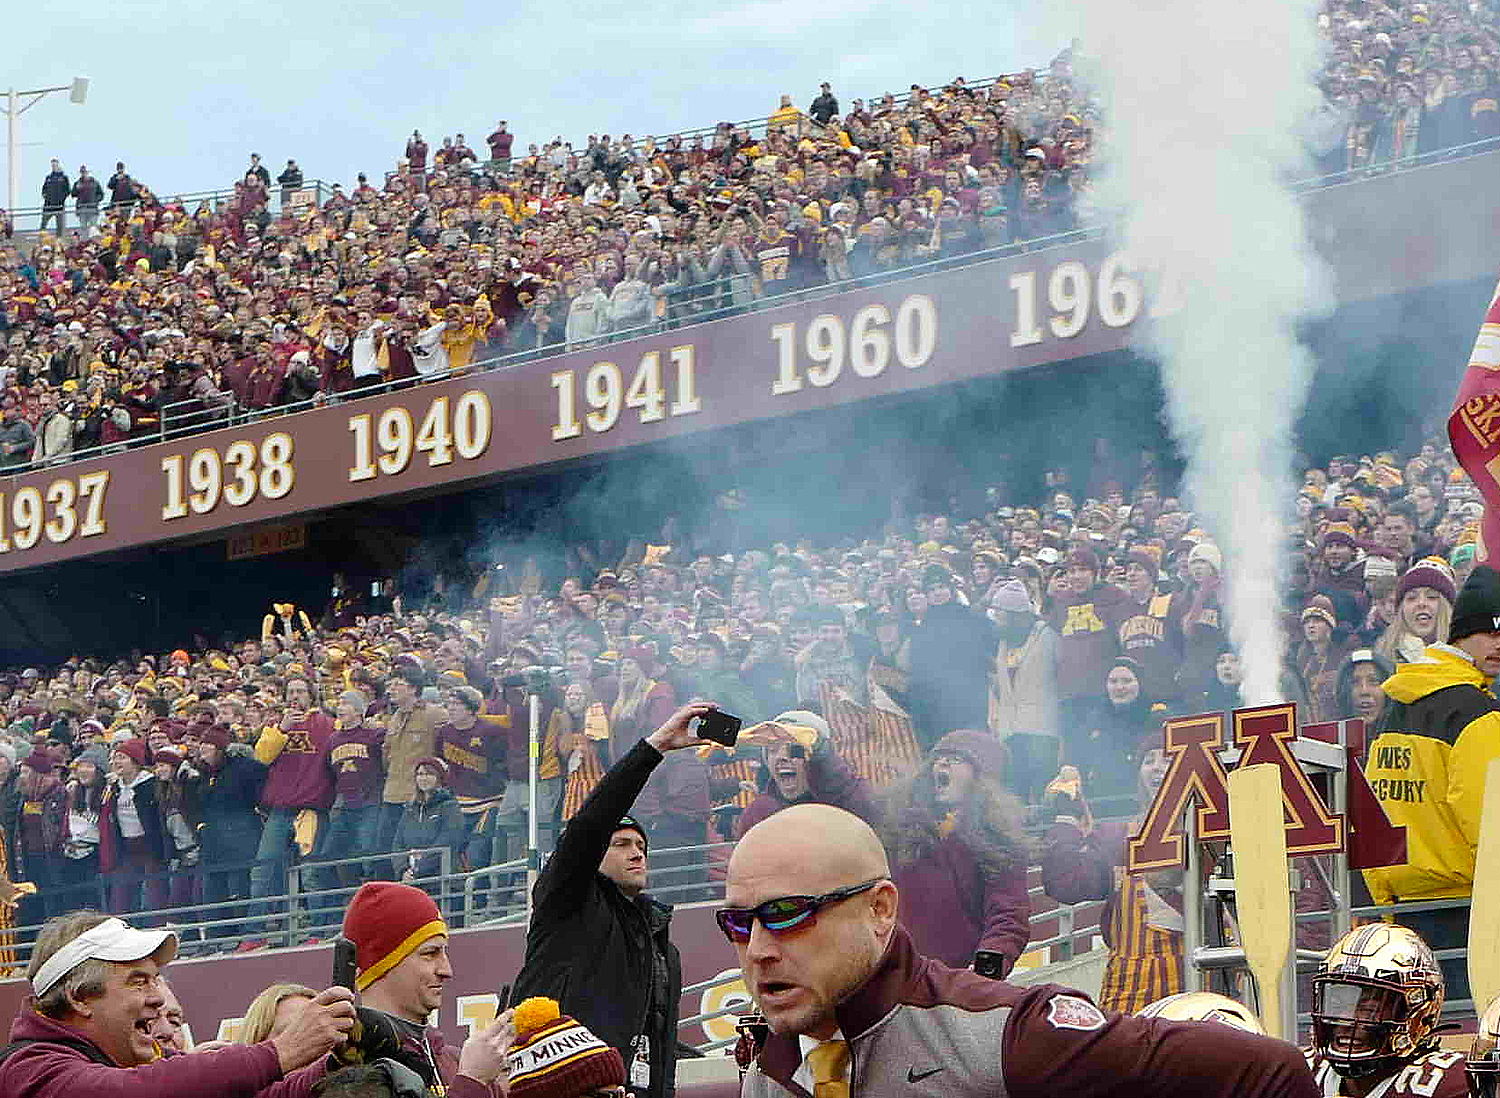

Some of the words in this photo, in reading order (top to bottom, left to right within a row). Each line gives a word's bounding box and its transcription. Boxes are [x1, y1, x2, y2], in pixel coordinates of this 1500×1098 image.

[770, 293, 938, 396] 1960
[1006, 246, 1165, 348] 196
[347, 390, 493, 482] 1940
[551, 343, 703, 441] 1941
[0, 470, 110, 552] 1937
[160, 432, 296, 520] 1938
